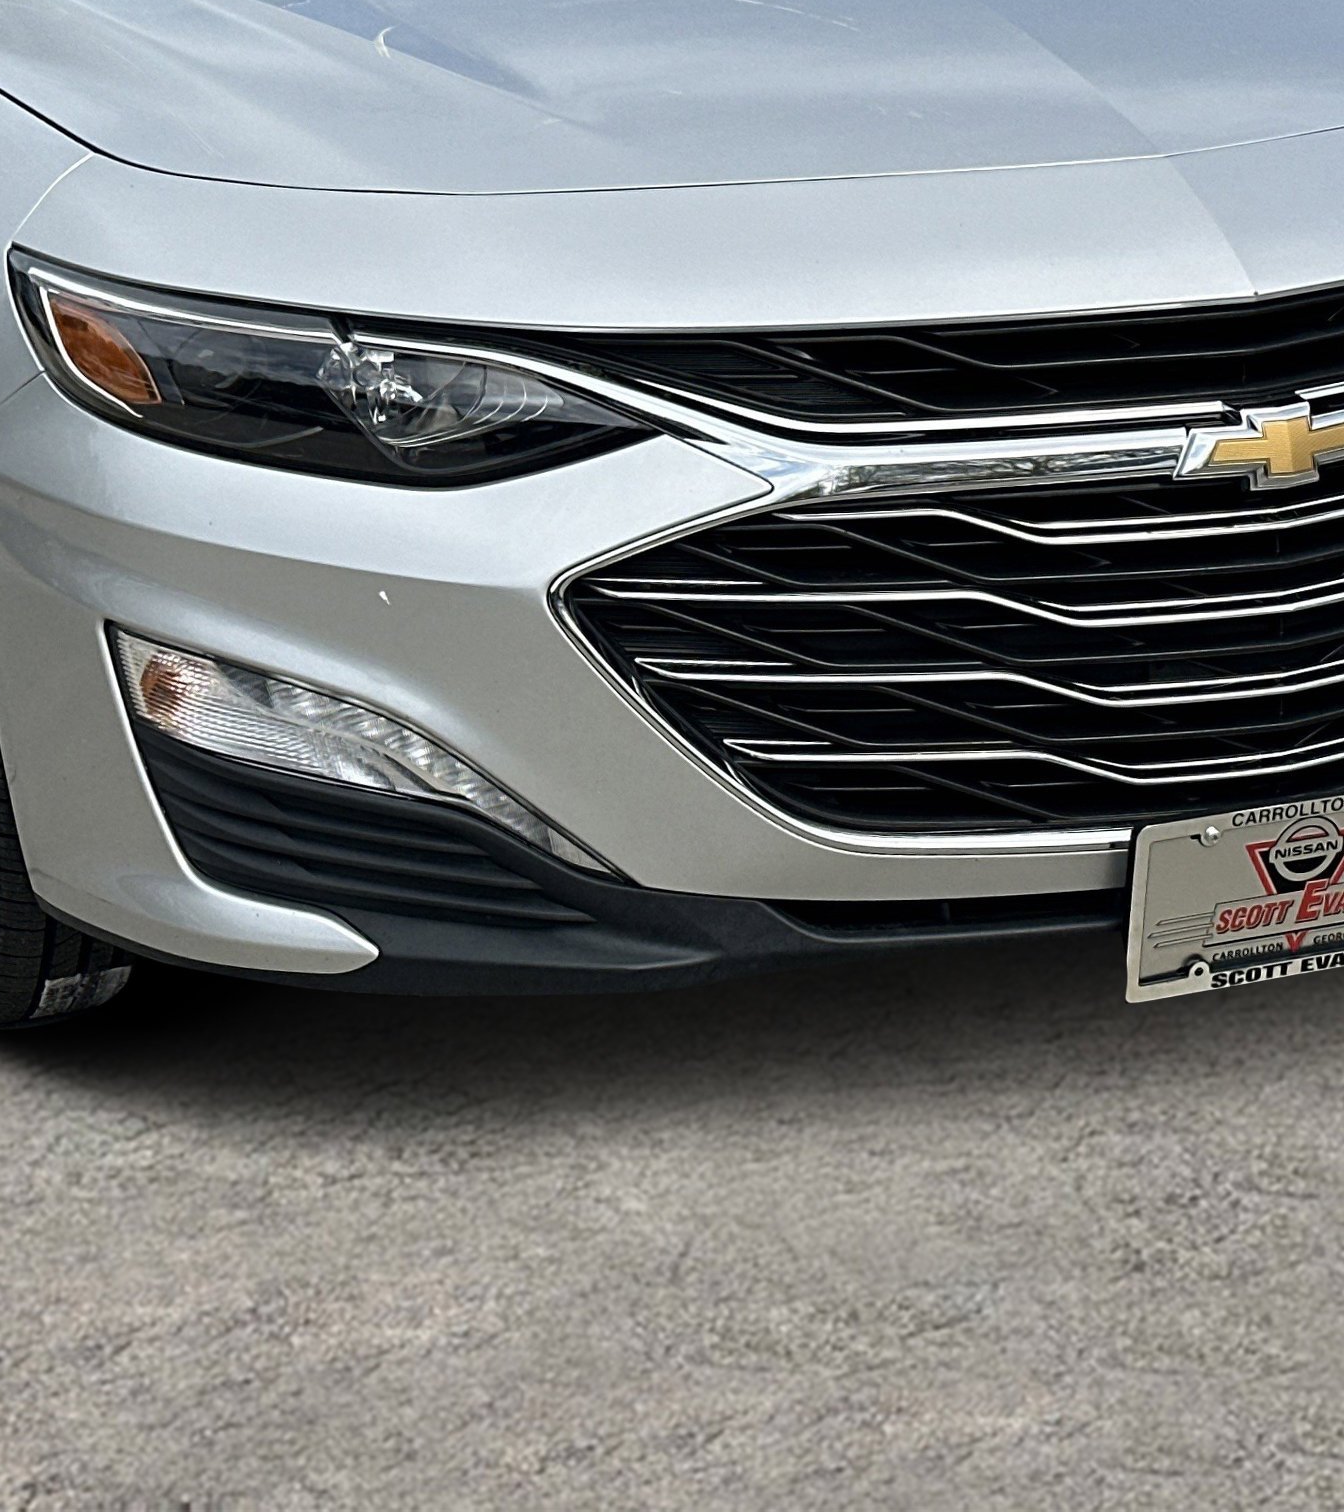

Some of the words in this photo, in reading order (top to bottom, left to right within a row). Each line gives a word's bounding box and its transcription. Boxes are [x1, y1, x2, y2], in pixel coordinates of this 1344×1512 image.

[1274, 839, 1339, 861] NISSAN
[1216, 899, 1294, 934] SCOTT
[1212, 942, 1284, 962] CARROLLTON
[1211, 961, 1293, 988] SCOTT
